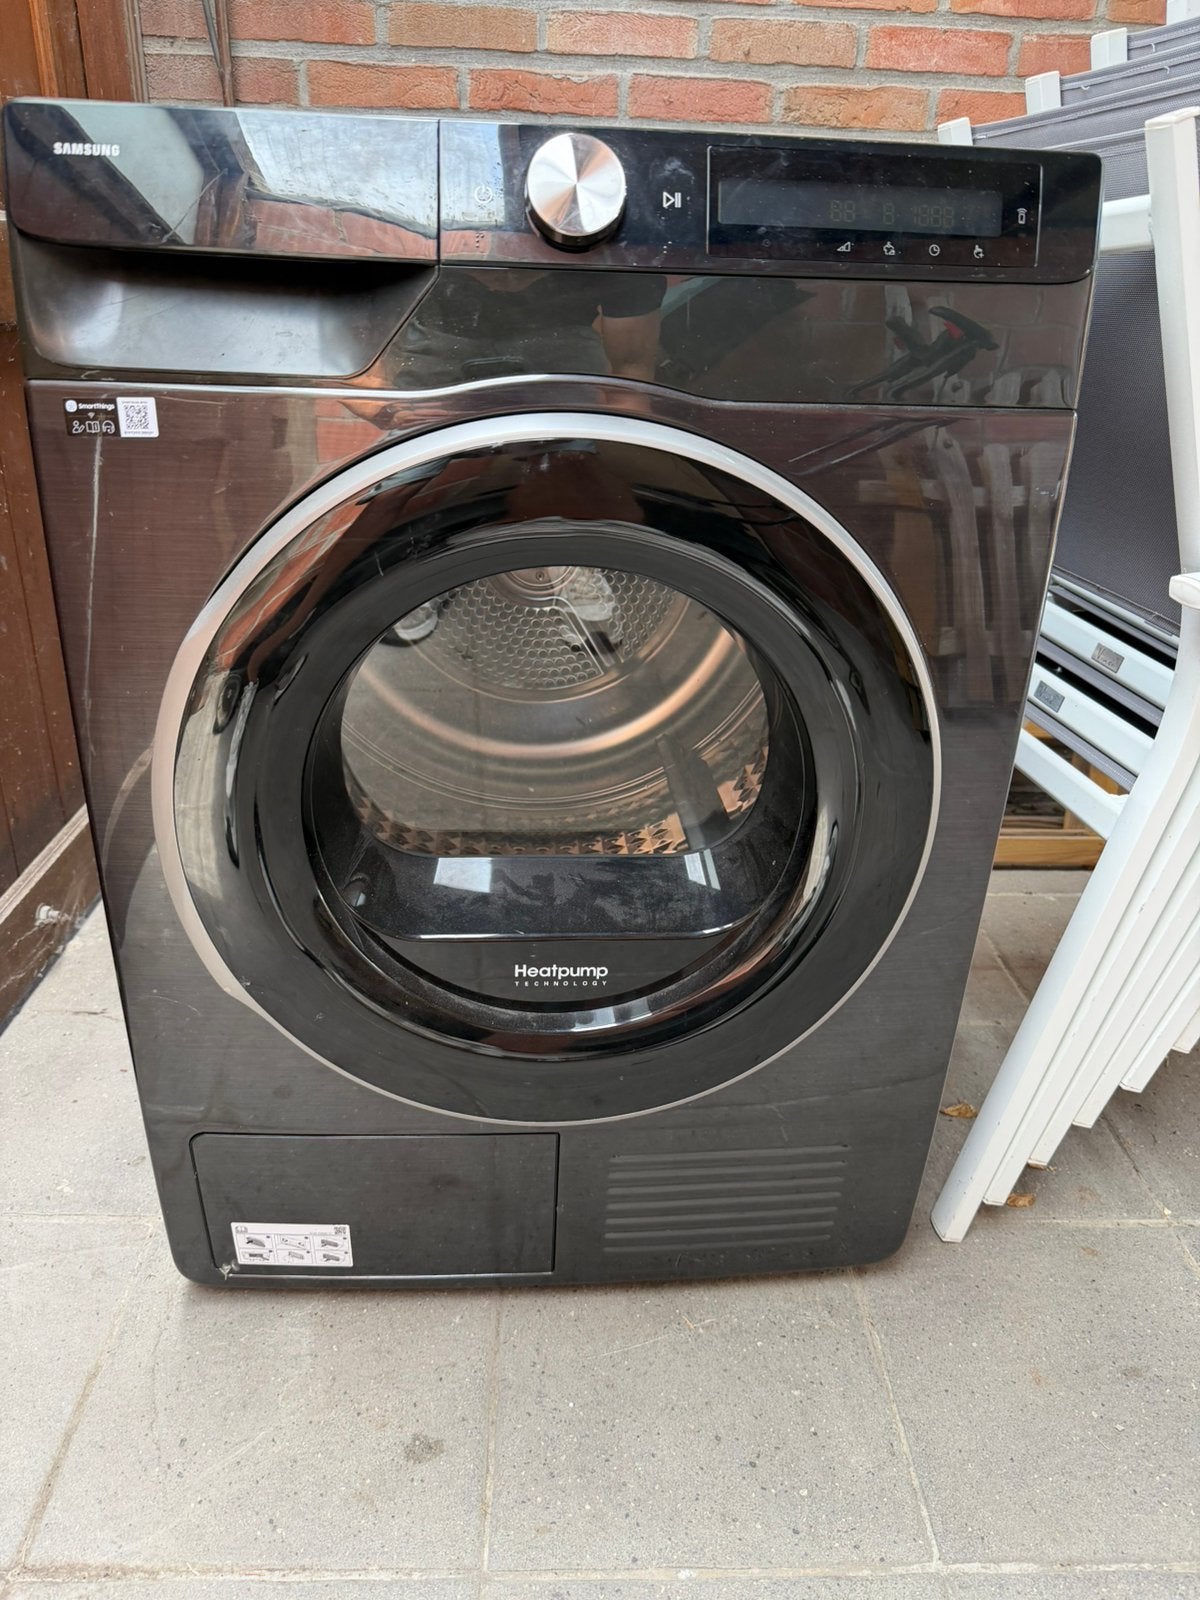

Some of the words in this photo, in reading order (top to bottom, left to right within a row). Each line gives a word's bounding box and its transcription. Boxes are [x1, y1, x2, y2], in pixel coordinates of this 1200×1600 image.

[53, 141, 120, 156] SAMSUNG
[78, 402, 115, 411] SmartThings
[514, 964, 608, 979] Heatpump
